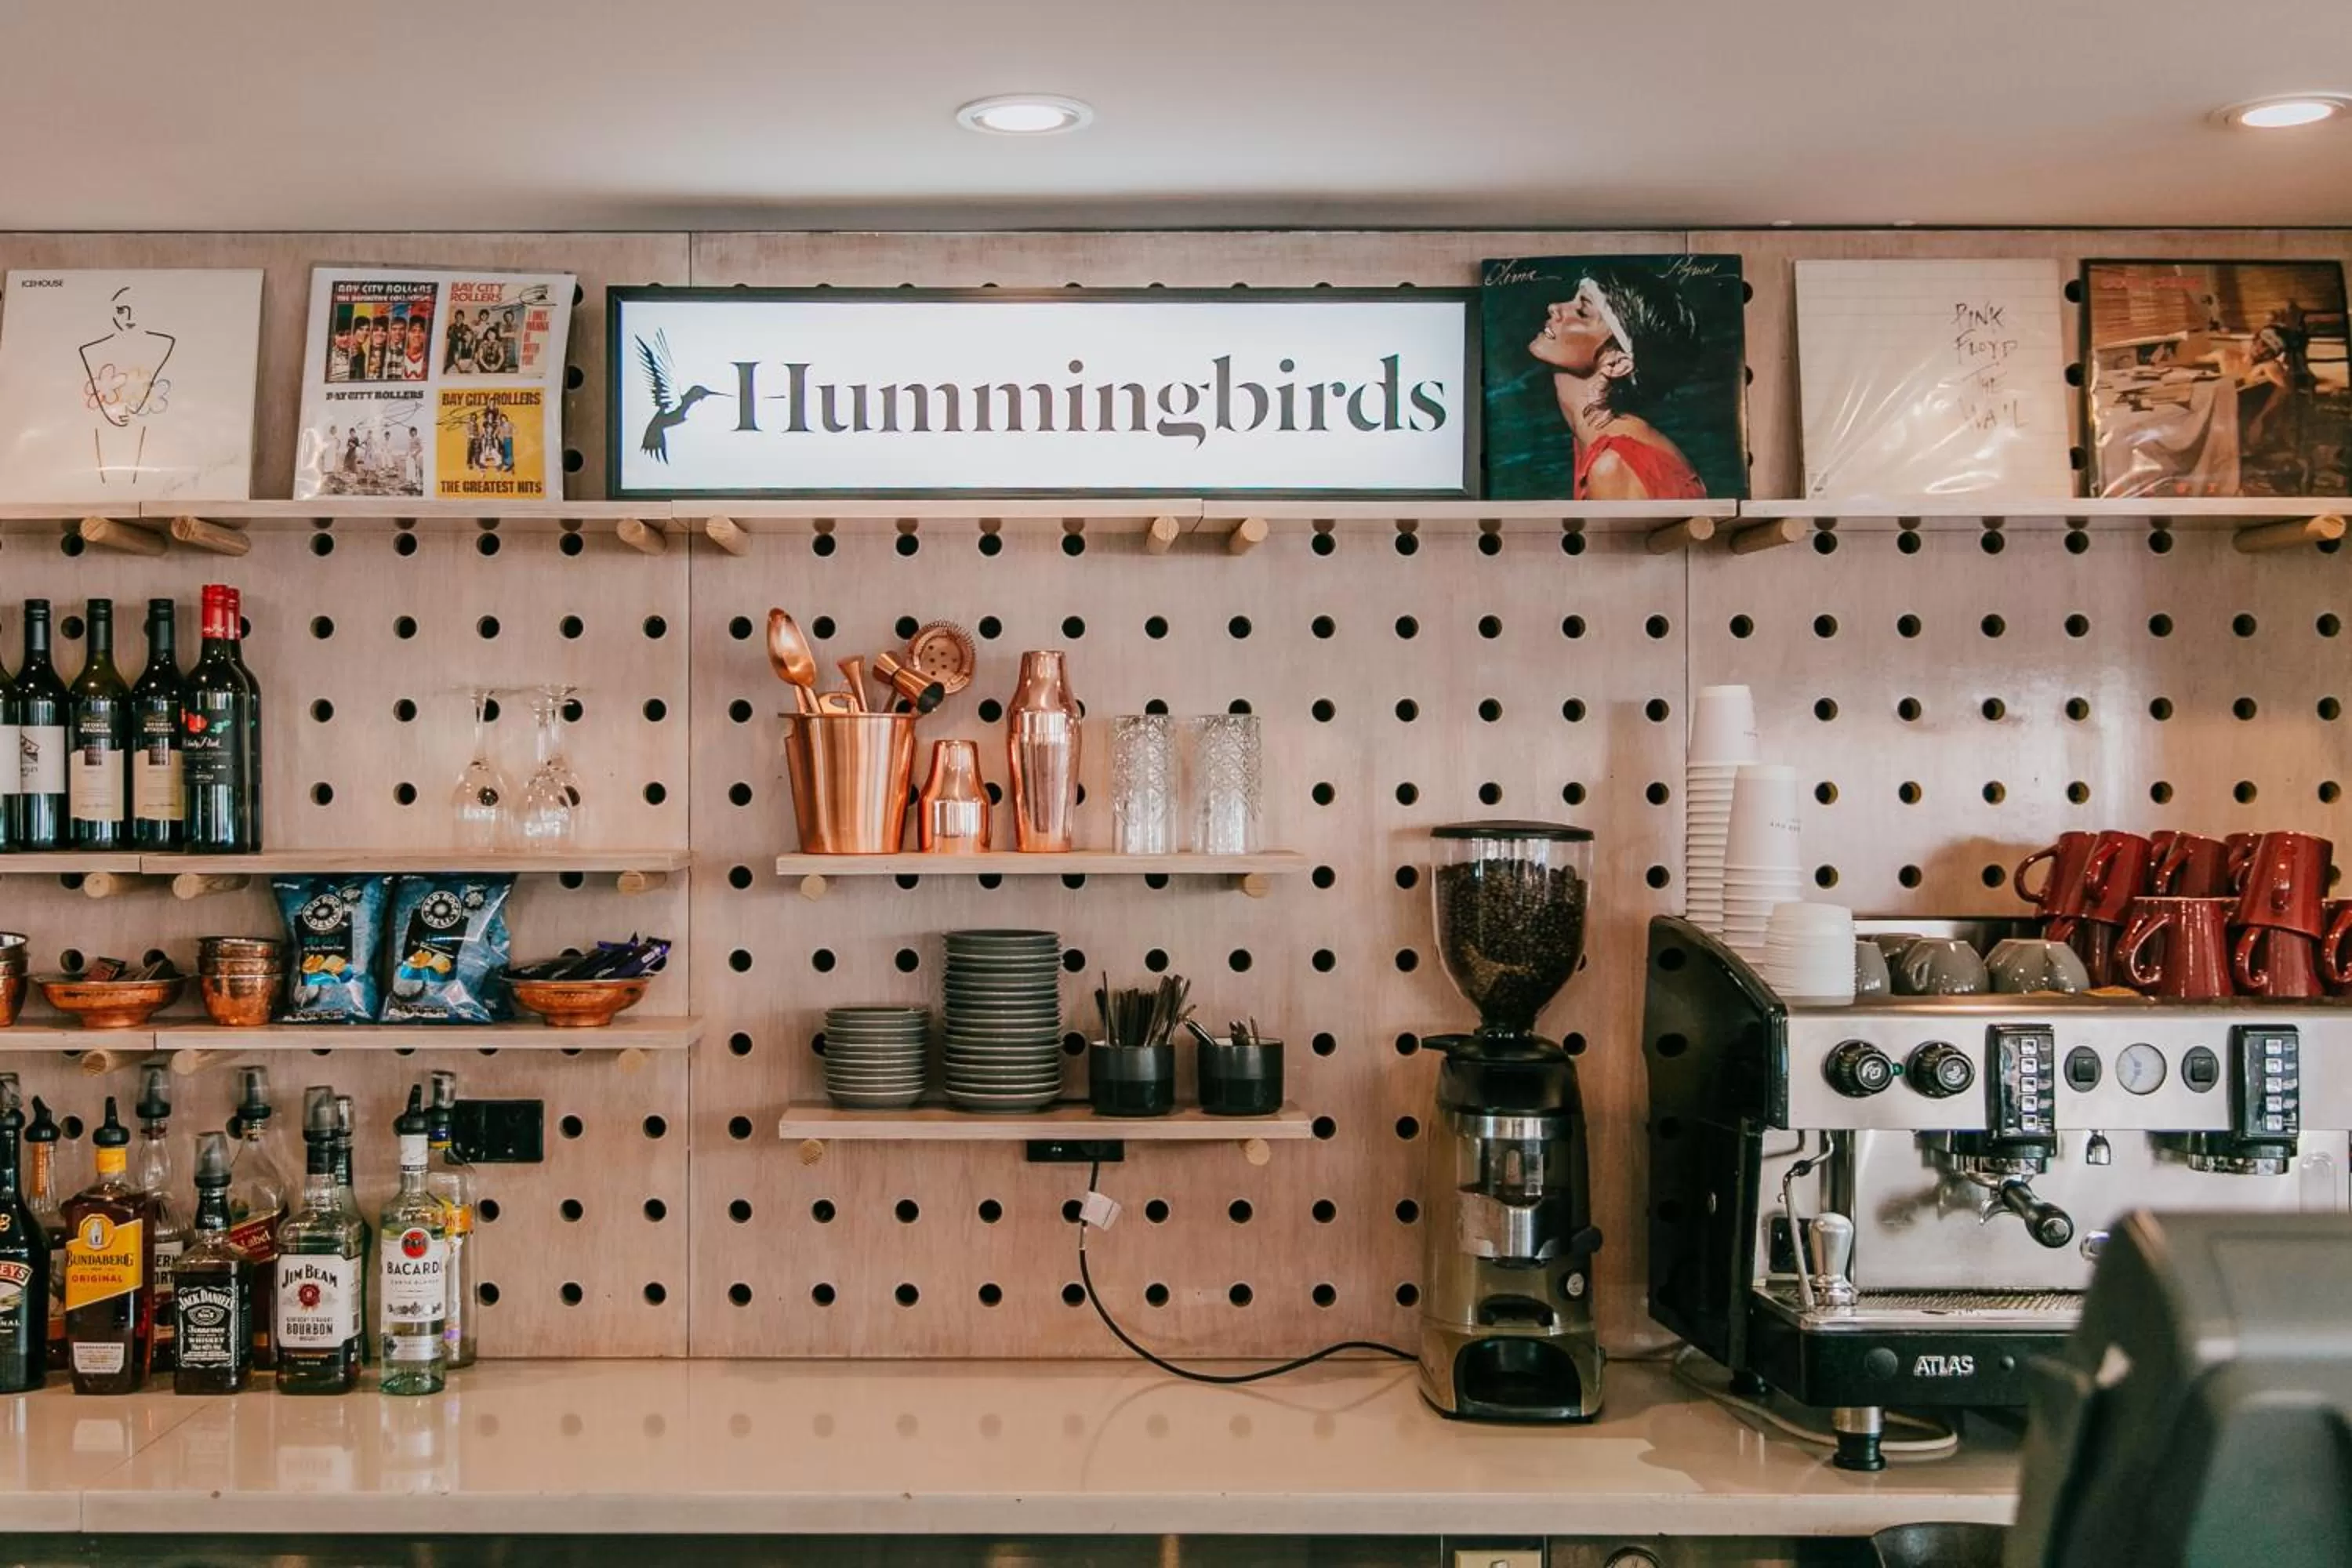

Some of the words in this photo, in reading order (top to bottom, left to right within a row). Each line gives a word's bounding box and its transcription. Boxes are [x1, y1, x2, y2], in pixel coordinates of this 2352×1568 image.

[361, 285, 384, 293] CITY
[451, 282, 474, 292] BAY
[477, 282, 506, 292] CITY
[450, 292, 503, 302] ROLLERS
[1951, 301, 2005, 328] PINK
[1953, 328, 2019, 365] FLOYD
[348, 390, 372, 400] CITY
[374, 390, 423, 399] ROLLERS
[441, 392, 464, 406] BAY
[466, 392, 489, 406] CITY
[491, 392, 541, 405] ROLLERS
[729, 354, 1446, 448] Hummingbirds
[1958, 395, 2030, 430] WAL
[441, 481, 461, 493] THE
[463, 481, 514, 493] GREATEST
[517, 481, 543, 493] HITS
[66, 1251, 134, 1267] BUNDABERG
[71, 1274, 123, 1283] ORIGINAL
[282, 1268, 303, 1288] JIM
[305, 1263, 338, 1287] BEAM
[179, 1292, 200, 1311] JACK
[286, 1323, 333, 1335] BOURBON
[1913, 1355, 1974, 1377] ATLAS
